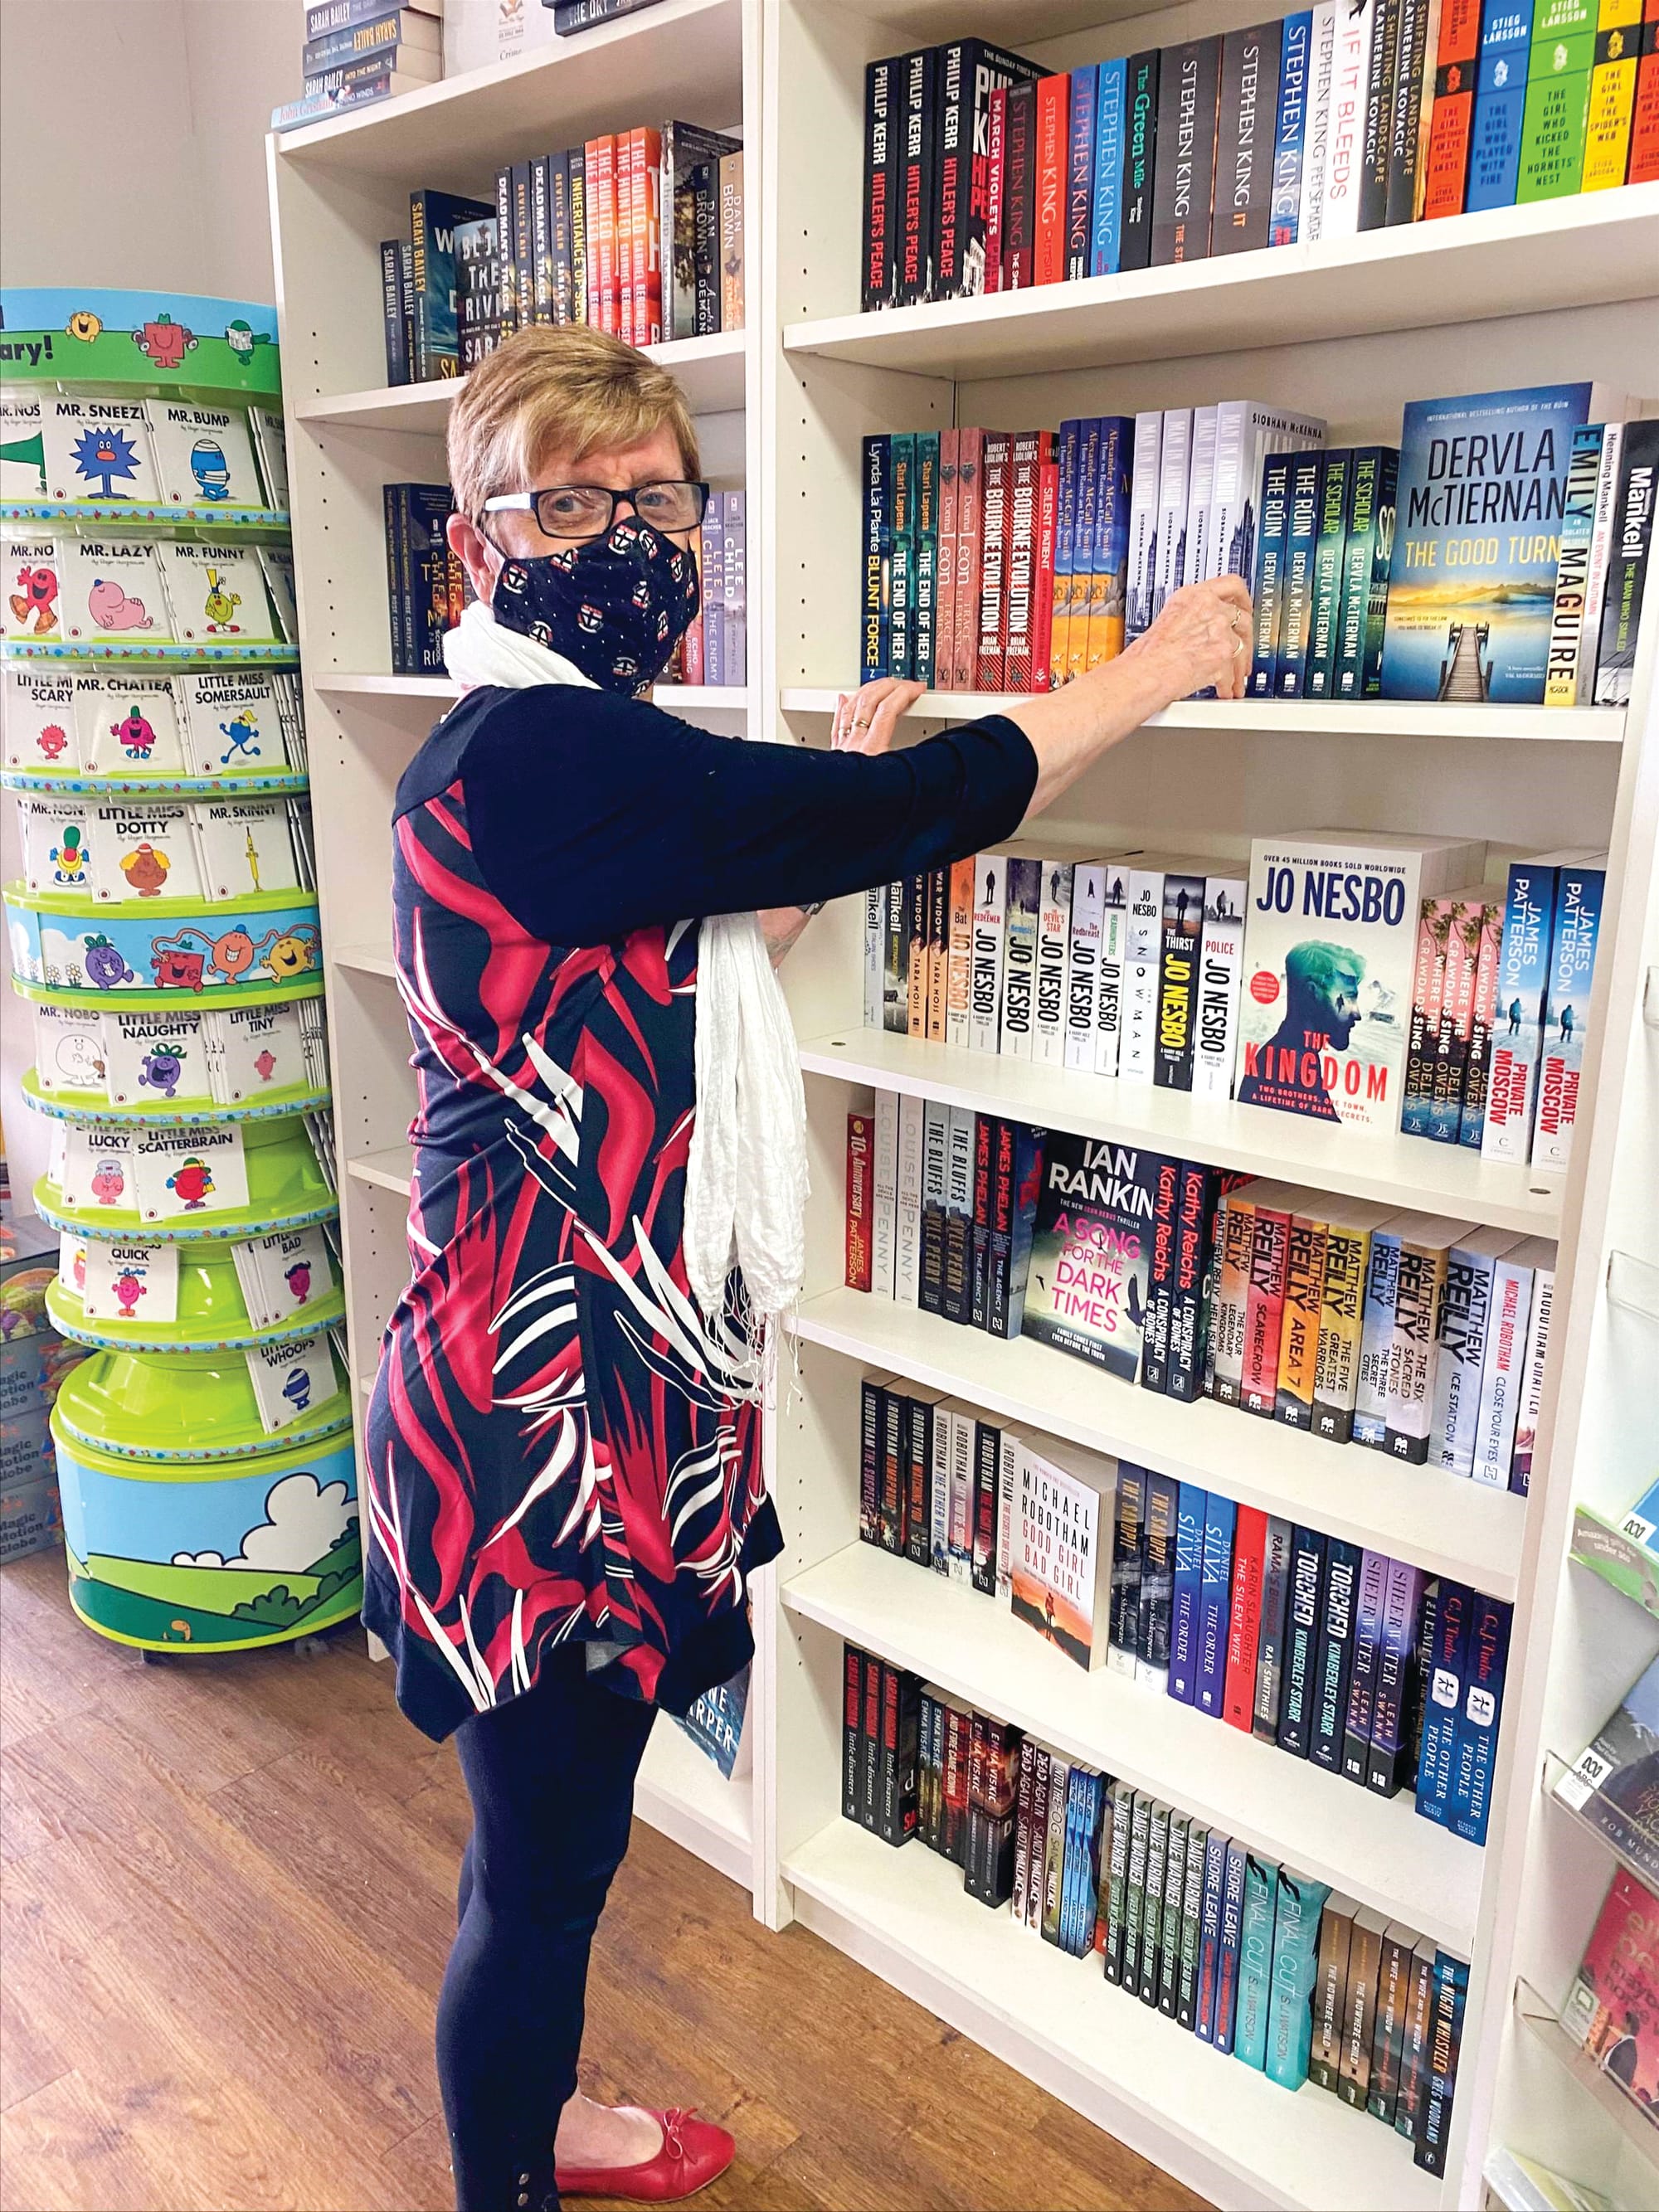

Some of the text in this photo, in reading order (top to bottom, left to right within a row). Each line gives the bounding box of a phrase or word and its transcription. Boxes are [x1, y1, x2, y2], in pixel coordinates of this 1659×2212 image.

[310, 3, 351, 32] SARAH BAILEY
[946, 46, 961, 102] PHILIP
[1365, 5, 1384, 164] KATHERINE KOVACIC
[944, 105, 959, 149] KERR
[1133, 65, 1150, 188] The Green Mile
[1276, 25, 1306, 214] STEPHEN KING
[1331, 28, 1360, 200] IF IT BLEEDS
[1373, 93, 1389, 184] LANDSCAPE
[988, 100, 1002, 236] MARCH VIOLETS
[1097, 71, 1120, 247] STEPHEN KING
[722, 182, 734, 248] BROWN
[733, 196, 742, 233] DAN
[940, 230, 954, 278] PEACE
[501, 264, 510, 313] TRACK
[56, 403, 85, 416] MR.
[168, 409, 229, 427] MR. BUMP
[1252, 412, 1287, 430] SIOBHAN
[871, 443, 883, 483] Lynda
[1268, 468, 1287, 494] THE
[1428, 428, 1554, 480] DERVLA
[1566, 428, 1601, 519] EMILY
[1599, 433, 1616, 521] Henning Mankell
[871, 504, 881, 552] Plante
[1041, 487, 1053, 570] SILENT PATIENT
[1622, 467, 1653, 559] Mankell
[80, 544, 153, 557] MR. LAZY
[176, 546, 245, 559] MR. FUNNY
[724, 537, 734, 598] CHILD
[735, 547, 743, 586] LEE
[980, 467, 1004, 632] THE BOURNE EVOLUTION
[1406, 536, 1559, 567] THE GOOD TURN
[868, 557, 881, 610] BLUNT
[892, 551, 906, 660] THE END OF HER
[866, 615, 879, 666] FORCE
[1549, 545, 1588, 683] MAGUIRE
[195, 687, 270, 704] SOMERSAULT
[198, 676, 236, 688] LITTLE
[116, 821, 168, 834] DOTTY
[1292, 858, 1319, 867] MILLION
[1321, 859, 1342, 868] BOOKS
[1345, 862, 1362, 870] SOLD
[1365, 864, 1406, 873] WORLDWIDE
[1132, 902, 1156, 917] NESBO
[1140, 890, 1151, 902] JO
[1256, 867, 1406, 926] JO NESBO
[1165, 935, 1194, 952] THIRST
[1205, 941, 1234, 955] POLICE
[1505, 878, 1529, 986] PATTERSON
[1521, 903, 1541, 966] JAMES
[1160, 954, 1191, 1048] JO NESBO
[1200, 960, 1230, 1053] JO NESBO
[123, 1022, 199, 1039] NAUGHTY
[1302, 1031, 1331, 1051] THE
[1410, 1012, 1423, 1051] SING
[1244, 1042, 1388, 1101] KINGDOM
[1489, 1049, 1513, 1125] MOSCOW
[1509, 1063, 1527, 1116] PRIVATE
[88, 1134, 129, 1148] LUCKY
[139, 1134, 233, 1155] SCATTERBRAIN
[927, 1122, 944, 1195] THE BLUFFS
[1083, 1140, 1137, 1179] IAN
[1048, 1162, 1155, 1220] RANKIN
[111, 1248, 149, 1261] QUICK
[1053, 1213, 1141, 1259] A SONG
[1062, 1244, 1125, 1275] FOR THE
[1152, 1165, 1175, 1363] Kathy Reichs CONSPIRACY
[1057, 1261, 1123, 1305] DARK
[1306, 1232, 1325, 1314] MATTHEW
[1052, 1287, 1118, 1332] TIMES
[1286, 1227, 1313, 1388] REILLY AREA 7
[1441, 1261, 1475, 1364] REILLY
[1467, 1270, 1490, 1368] MATTHEW
[1250, 1302, 1267, 1385] SCARECROW
[1486, 1279, 1519, 1461] MICHAEL ROBOTHAM CLOSE YOUR EYES
[1445, 1372, 1461, 1443] ICE STATION
[1022, 1495, 1088, 1557] ROBOTHAM
[1024, 1469, 1089, 1530] MICHAEL
[1023, 1519, 1086, 1578] GOOD GIRL
[1024, 1544, 1081, 1601] BAD GIRL
[1203, 1524, 1223, 1675] SILVA THE ORDER
[1231, 1557, 1247, 1665] THE SILENT WIFE
[1287, 1548, 1319, 1723] TORCHED KIMBERLEY STARR
[1457, 1743, 1472, 1799] PEOPLE
[1470, 1734, 1489, 1819] THE OTHER
[1204, 1846, 1222, 1937] SHORE LEAVE
[1278, 1899, 1301, 1996] FINAL CUT
[1433, 1964, 1454, 2073] THE NIGHT WHISTLER
